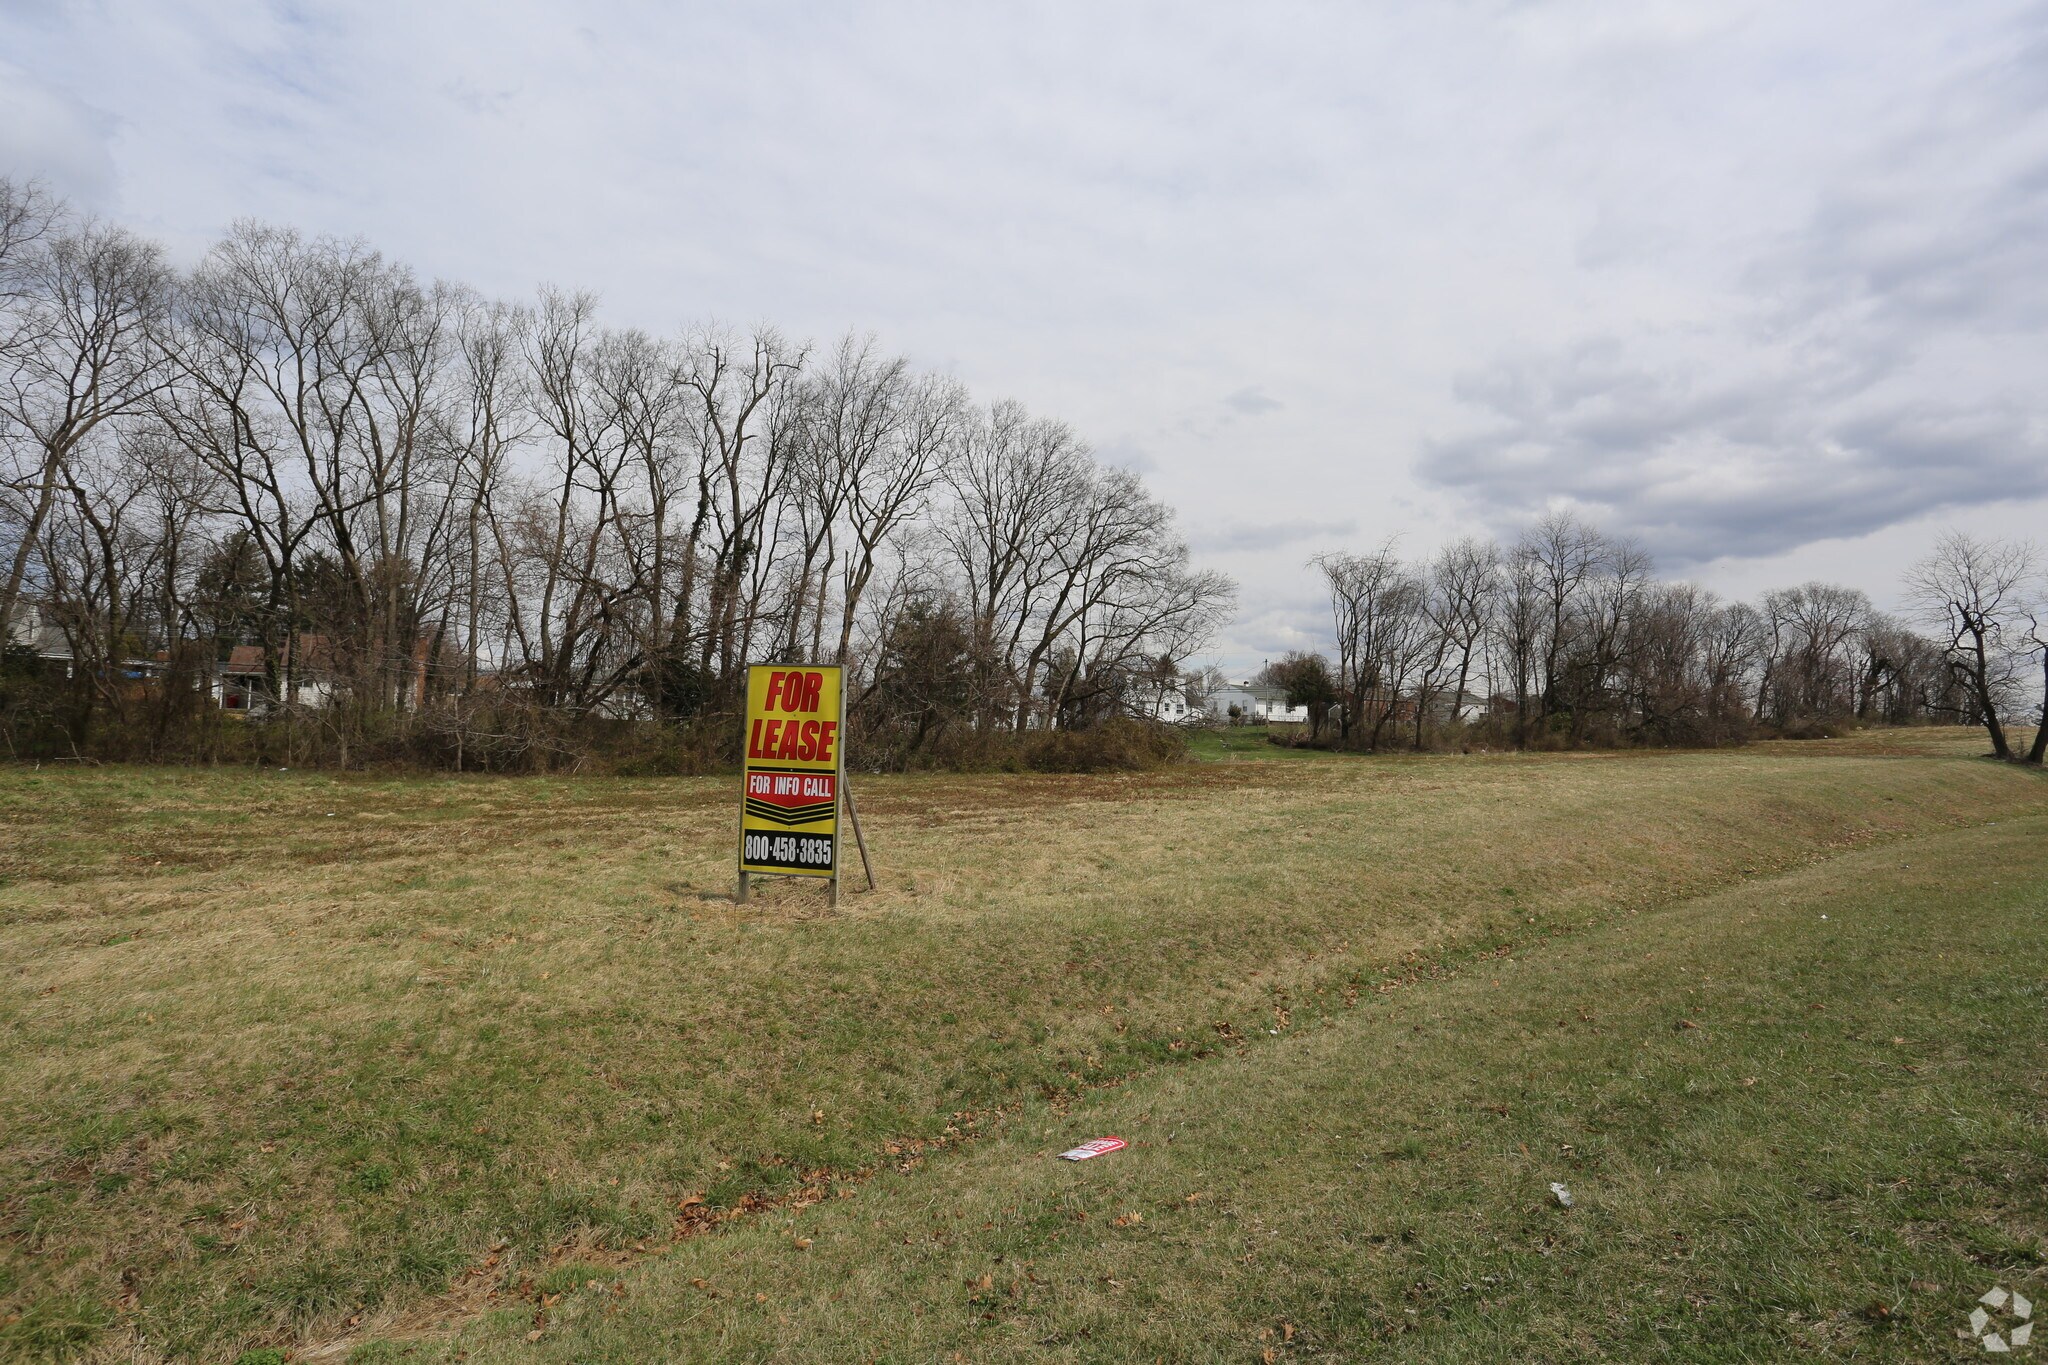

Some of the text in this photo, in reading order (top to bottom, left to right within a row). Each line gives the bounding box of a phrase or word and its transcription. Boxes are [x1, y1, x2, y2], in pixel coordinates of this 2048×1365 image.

[765, 671, 823, 712] FOR
[748, 719, 837, 761] LEASE
[750, 775, 831, 797] FOR INFO CALL
